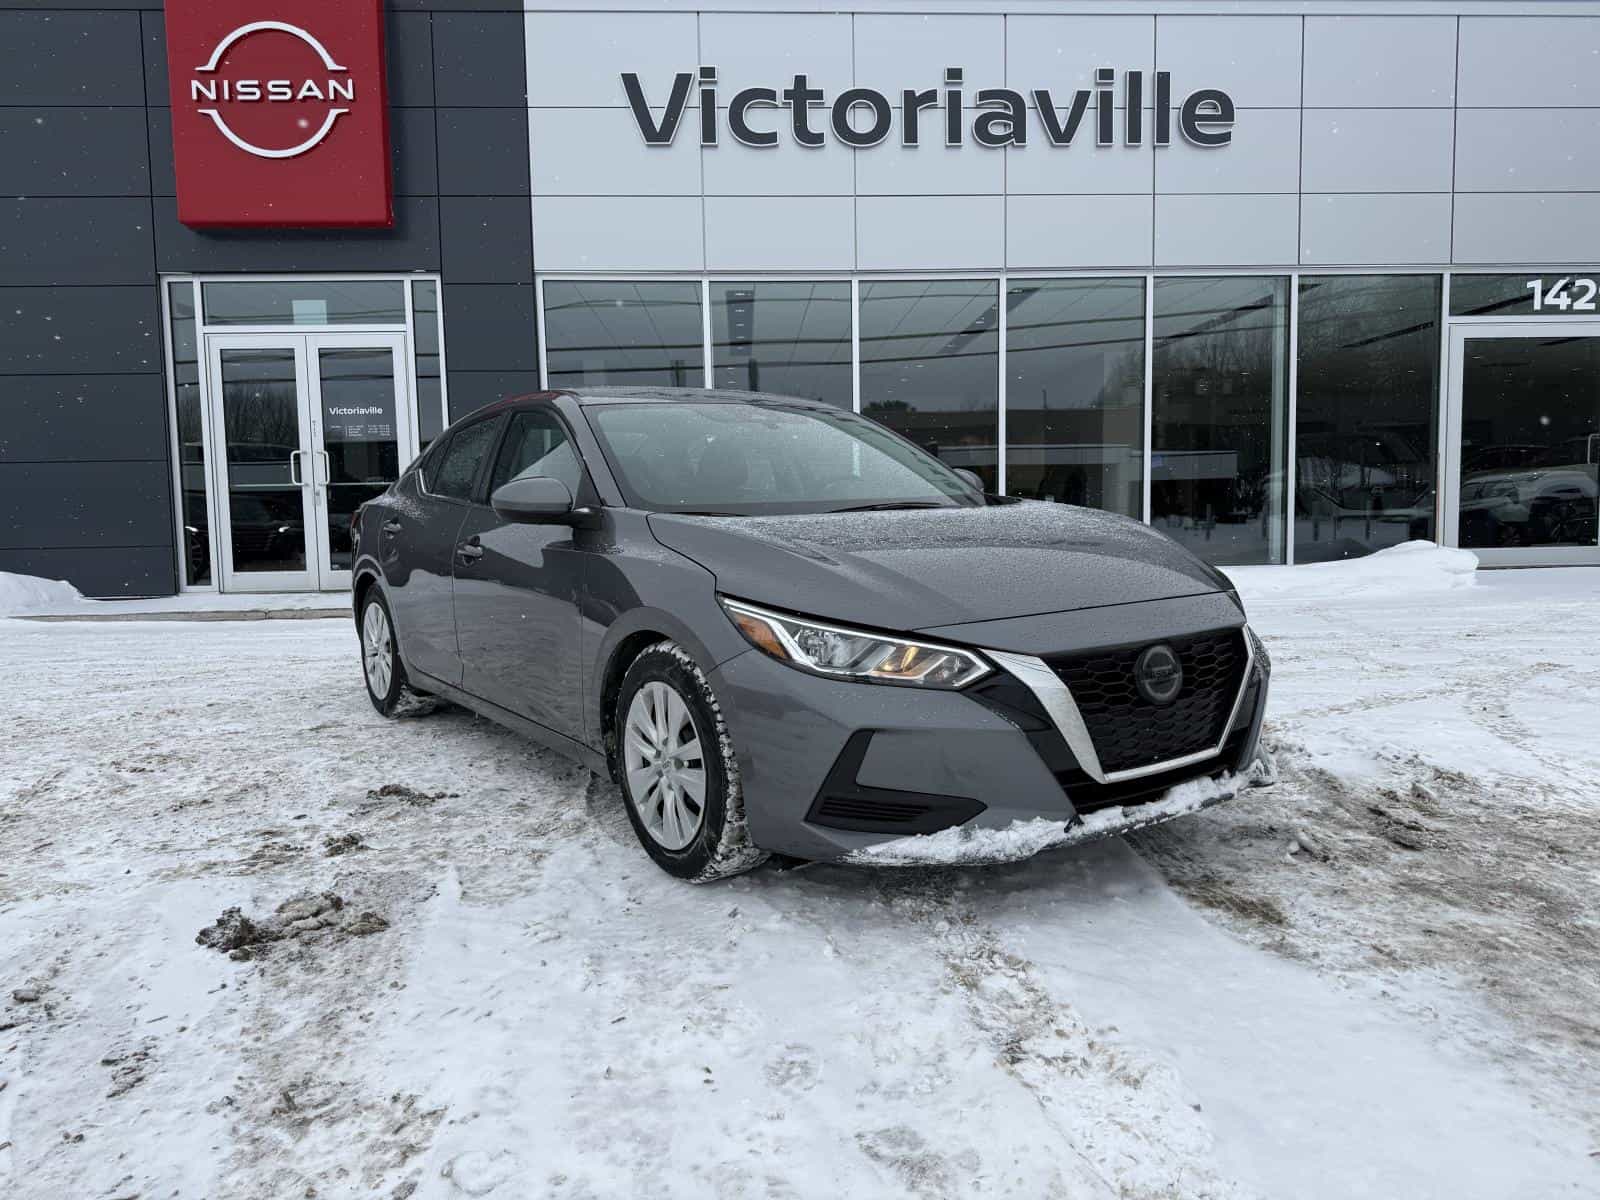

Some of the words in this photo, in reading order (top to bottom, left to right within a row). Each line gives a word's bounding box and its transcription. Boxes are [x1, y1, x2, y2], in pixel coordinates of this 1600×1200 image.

[190, 79, 355, 101] NISSAN
[619, 66, 1236, 148] Victoriaville
[1526, 277, 1600, 310] 142
[329, 406, 383, 415] Victoriaville
